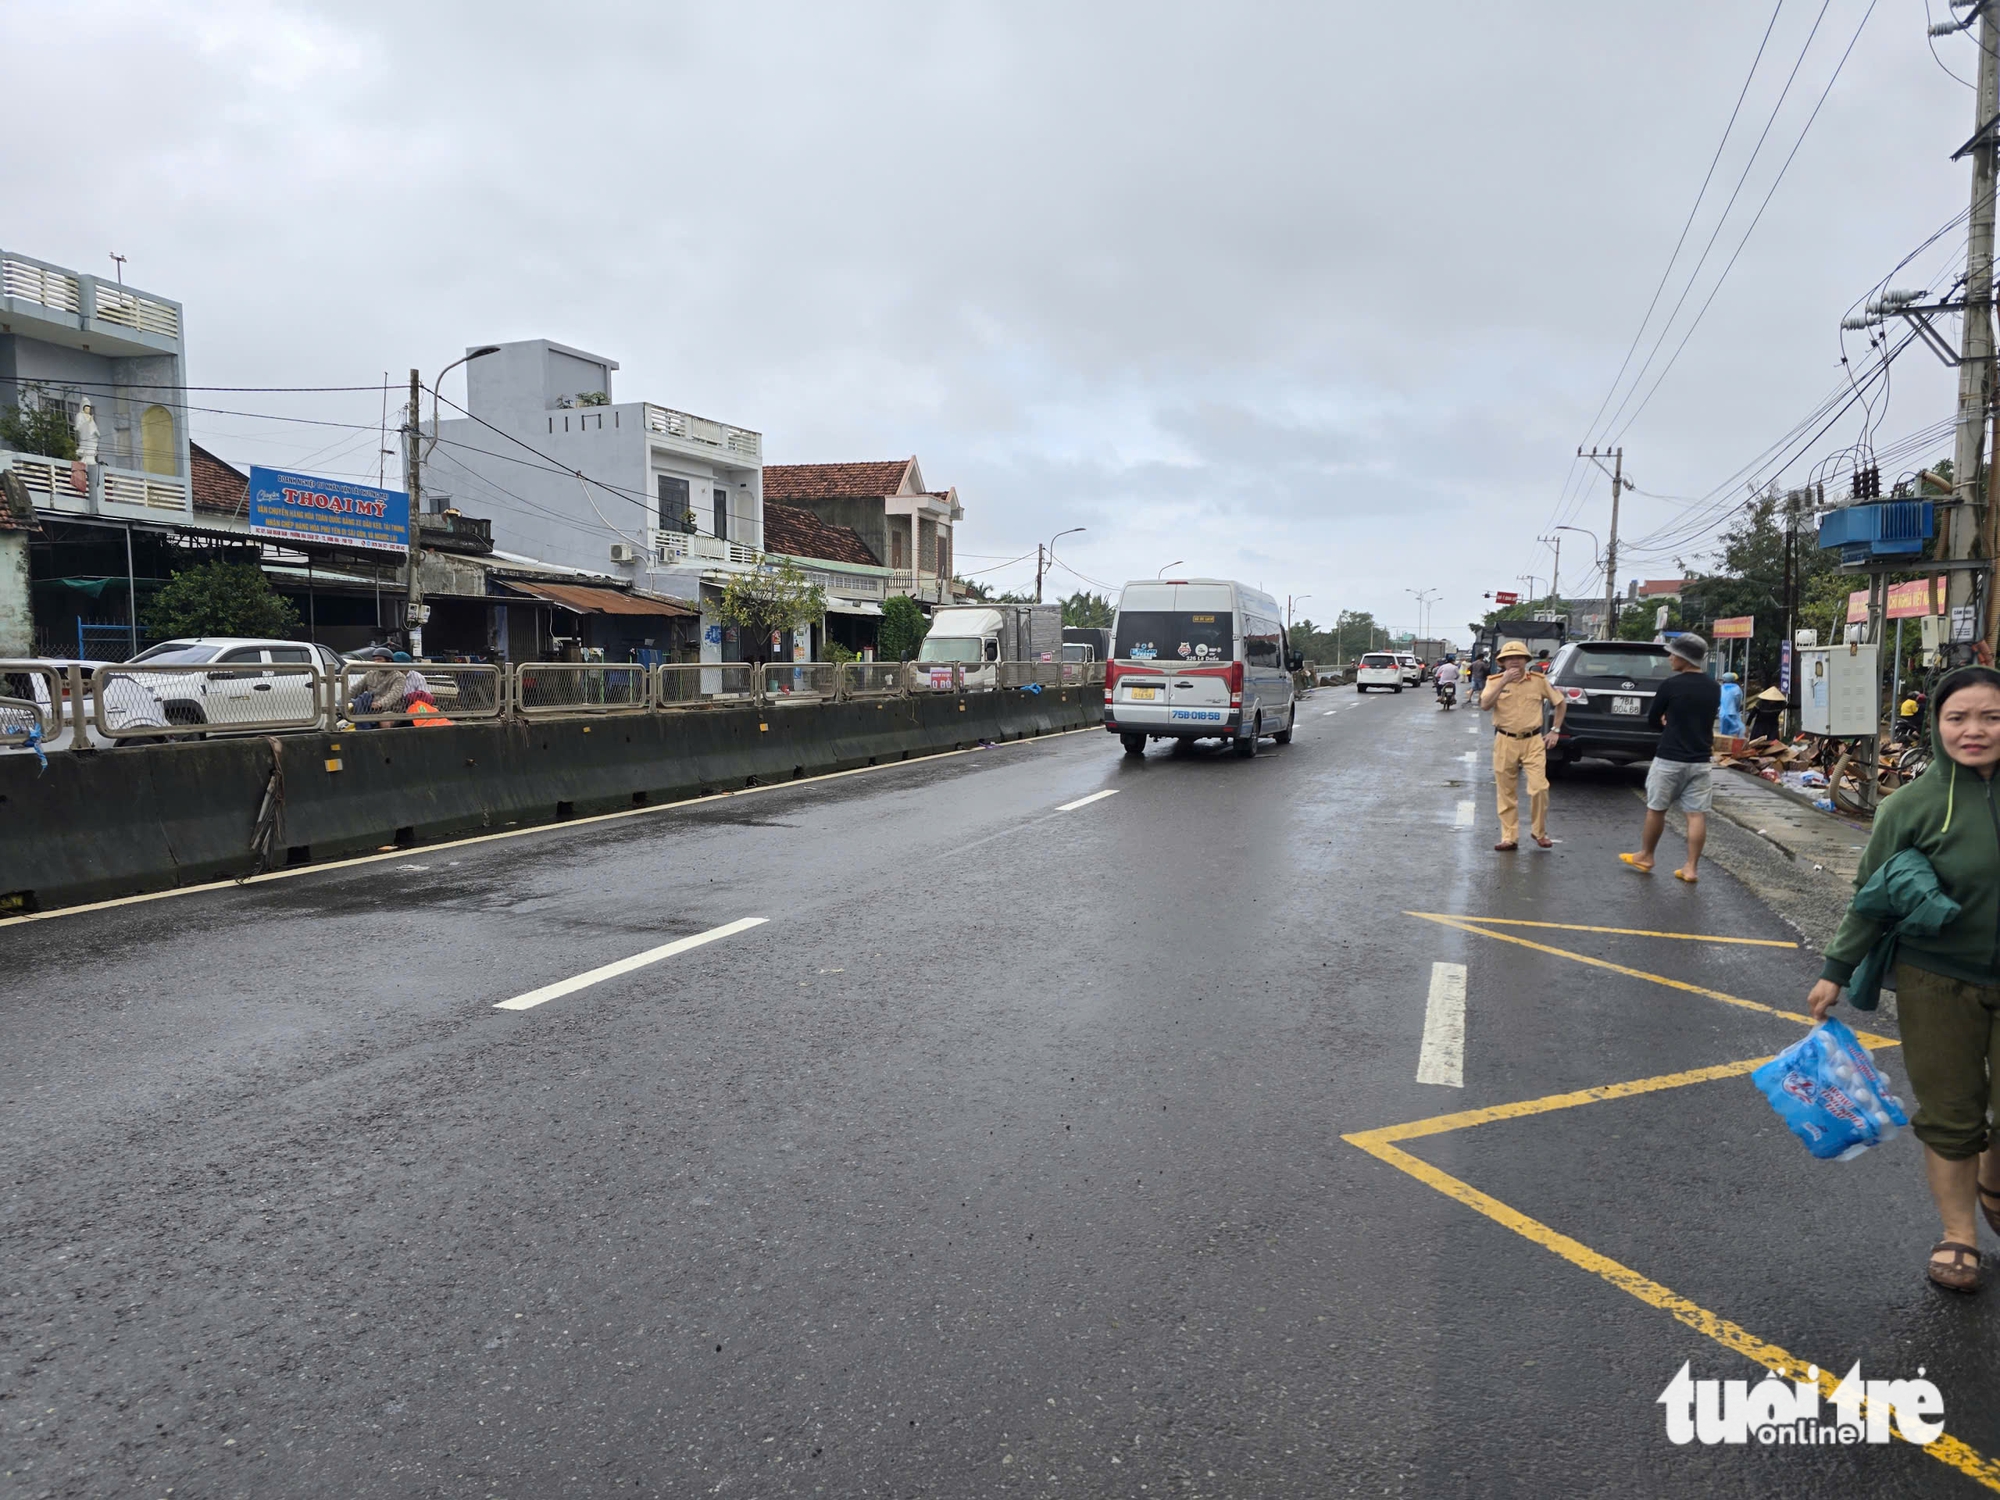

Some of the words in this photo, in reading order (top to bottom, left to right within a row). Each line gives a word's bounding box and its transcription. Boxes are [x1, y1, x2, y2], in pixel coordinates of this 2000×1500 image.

[283, 488, 353, 514] THOẠI
[356, 499, 387, 518] MỸ
[1619, 697, 1634, 706] 78A
